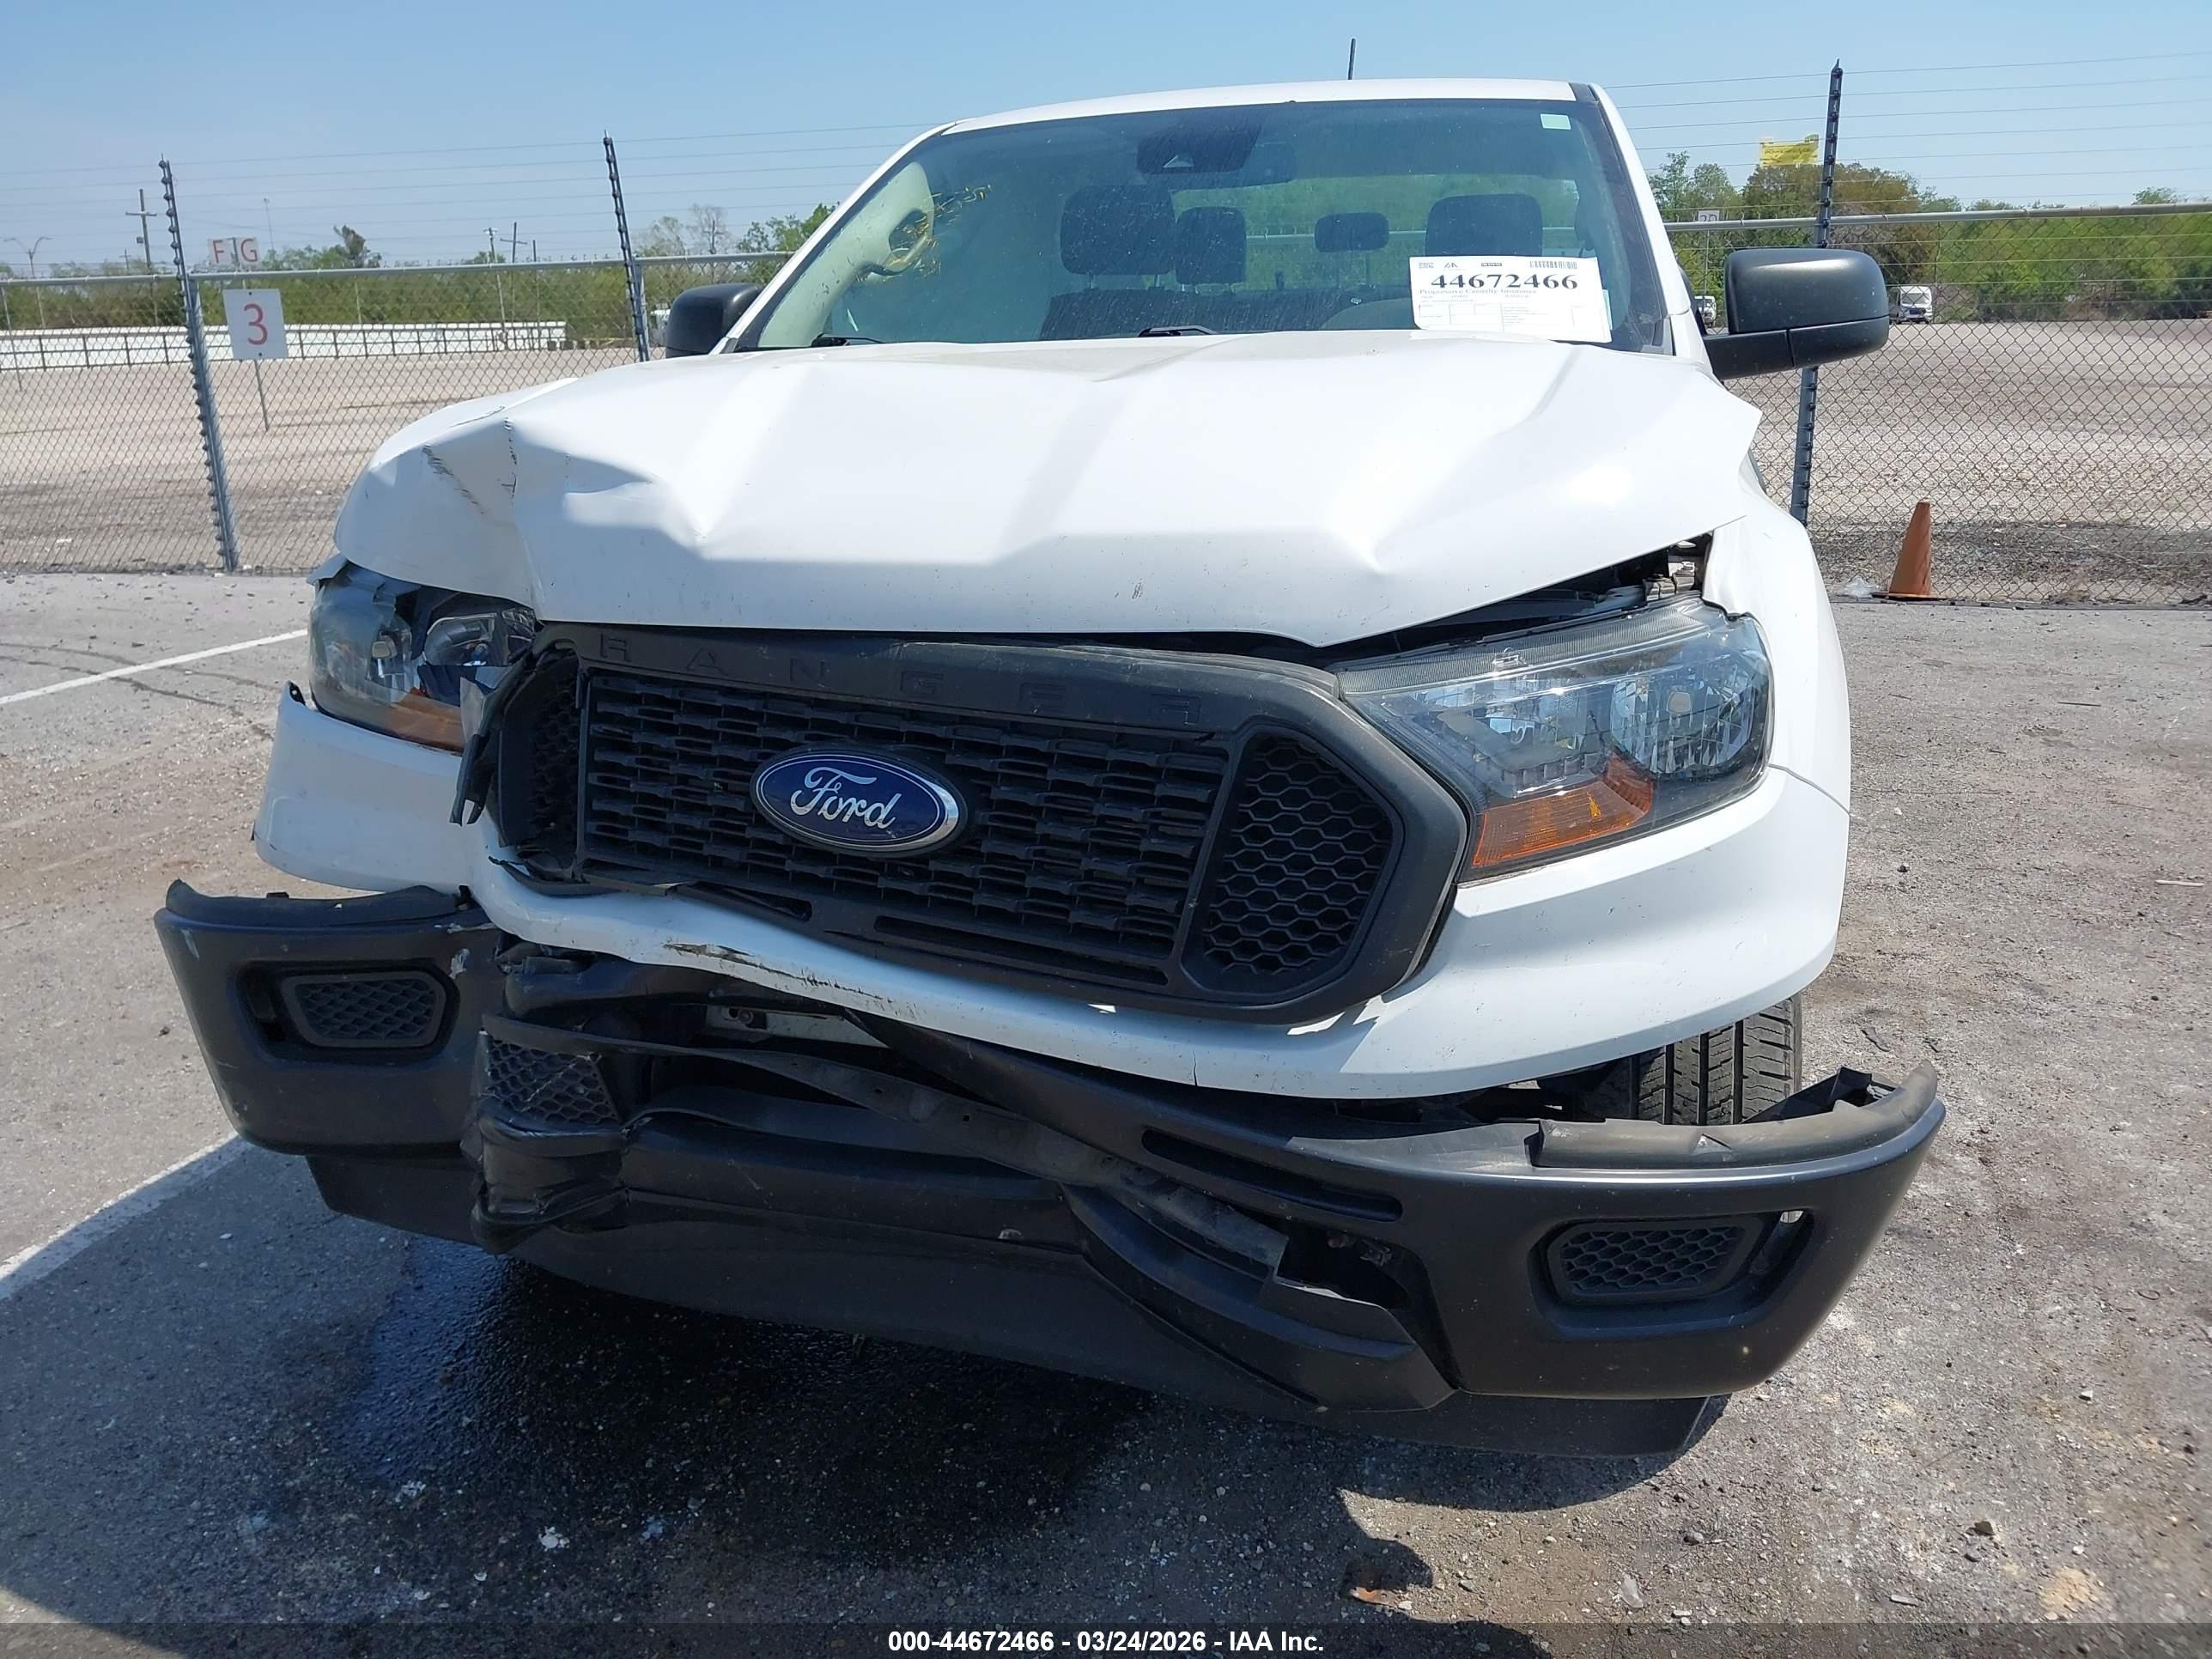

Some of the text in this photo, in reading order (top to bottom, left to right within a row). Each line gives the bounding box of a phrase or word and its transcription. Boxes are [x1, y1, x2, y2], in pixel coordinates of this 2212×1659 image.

[1431, 273, 1578, 289] 44672466
[244, 303, 268, 345] 3
[599, 634, 1201, 726] RANGER
[790, 767, 902, 829] Ford
